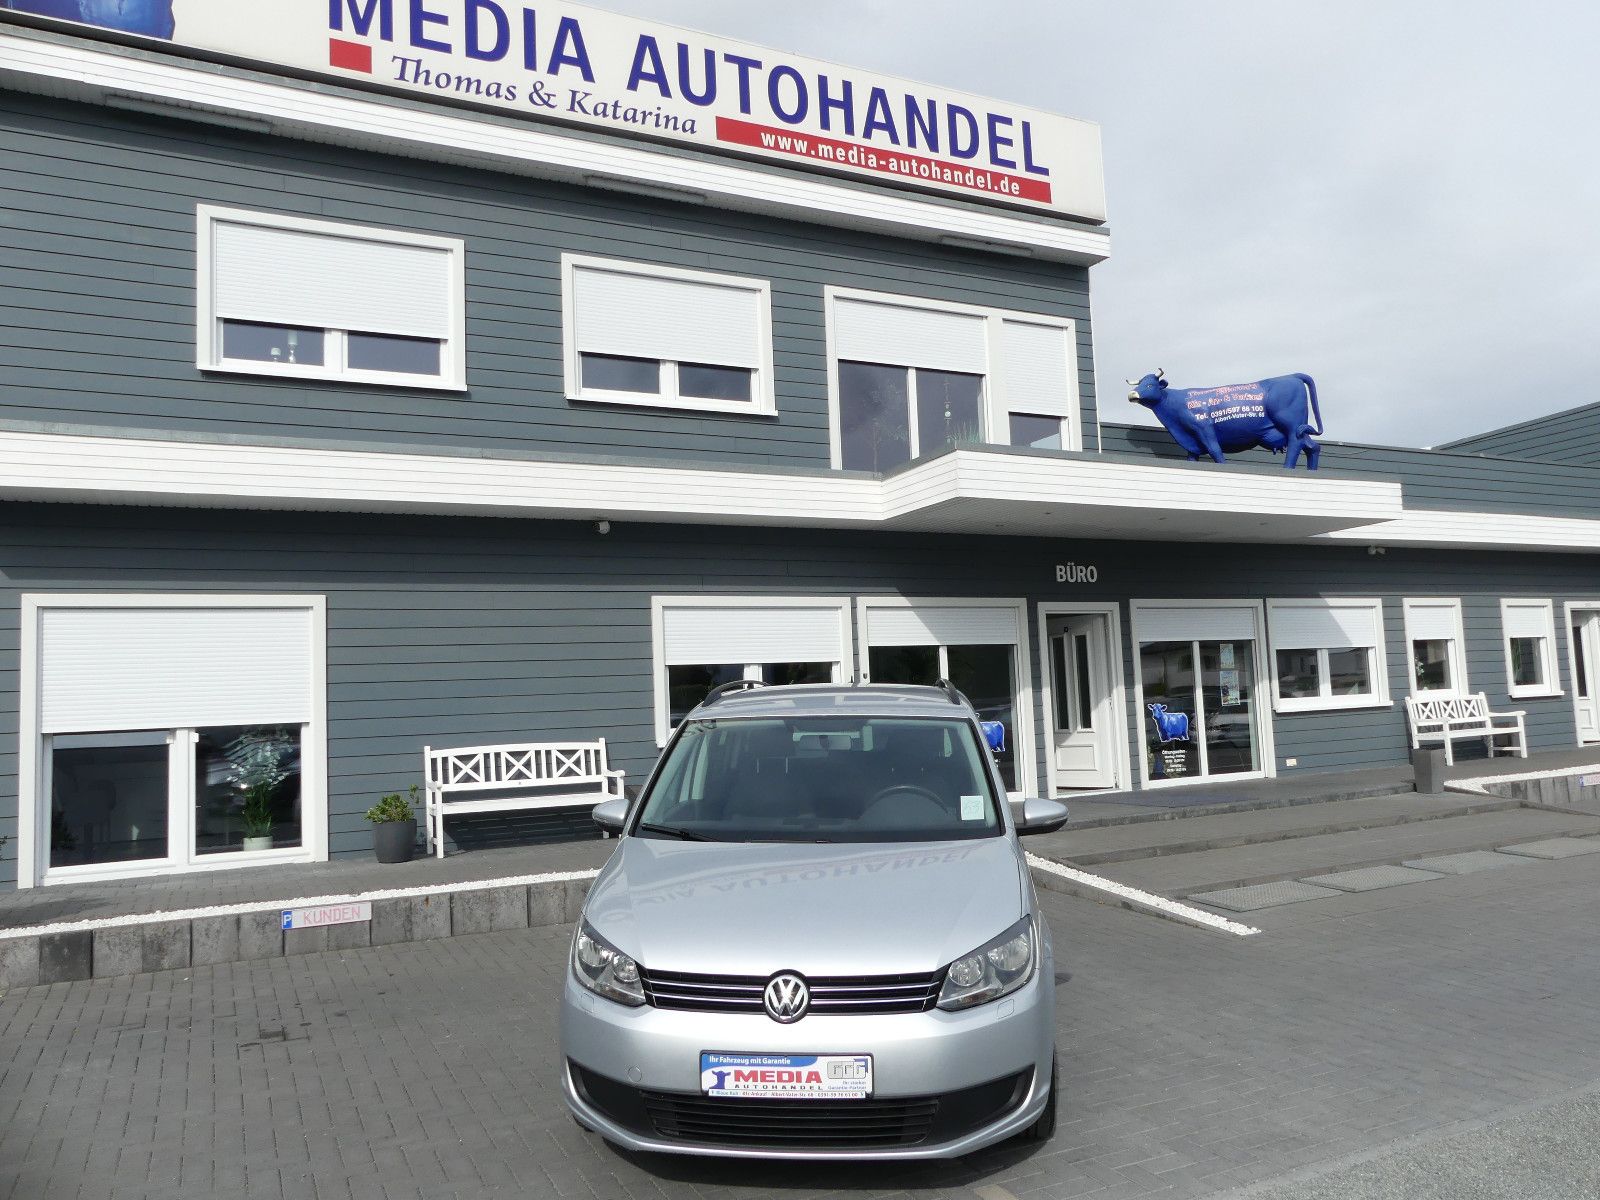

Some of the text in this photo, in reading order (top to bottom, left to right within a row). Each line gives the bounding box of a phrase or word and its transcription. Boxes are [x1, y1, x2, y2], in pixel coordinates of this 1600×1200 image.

[391, 55, 698, 135] Thomas & Katarina
[626, 33, 1050, 177] AUTOHANDEL
[760, 131, 1020, 196] www.media-autohandel.de
[1194, 412, 1209, 421] Tel.
[1056, 561, 1098, 583] BÜRO
[283, 906, 361, 926] P KUNDEN
[709, 1055, 791, 1065] Ihr Fahrzeug mit Garantie
[734, 1069, 823, 1084] MEDIA
[734, 1083, 823, 1091] AUTOHANDEL
